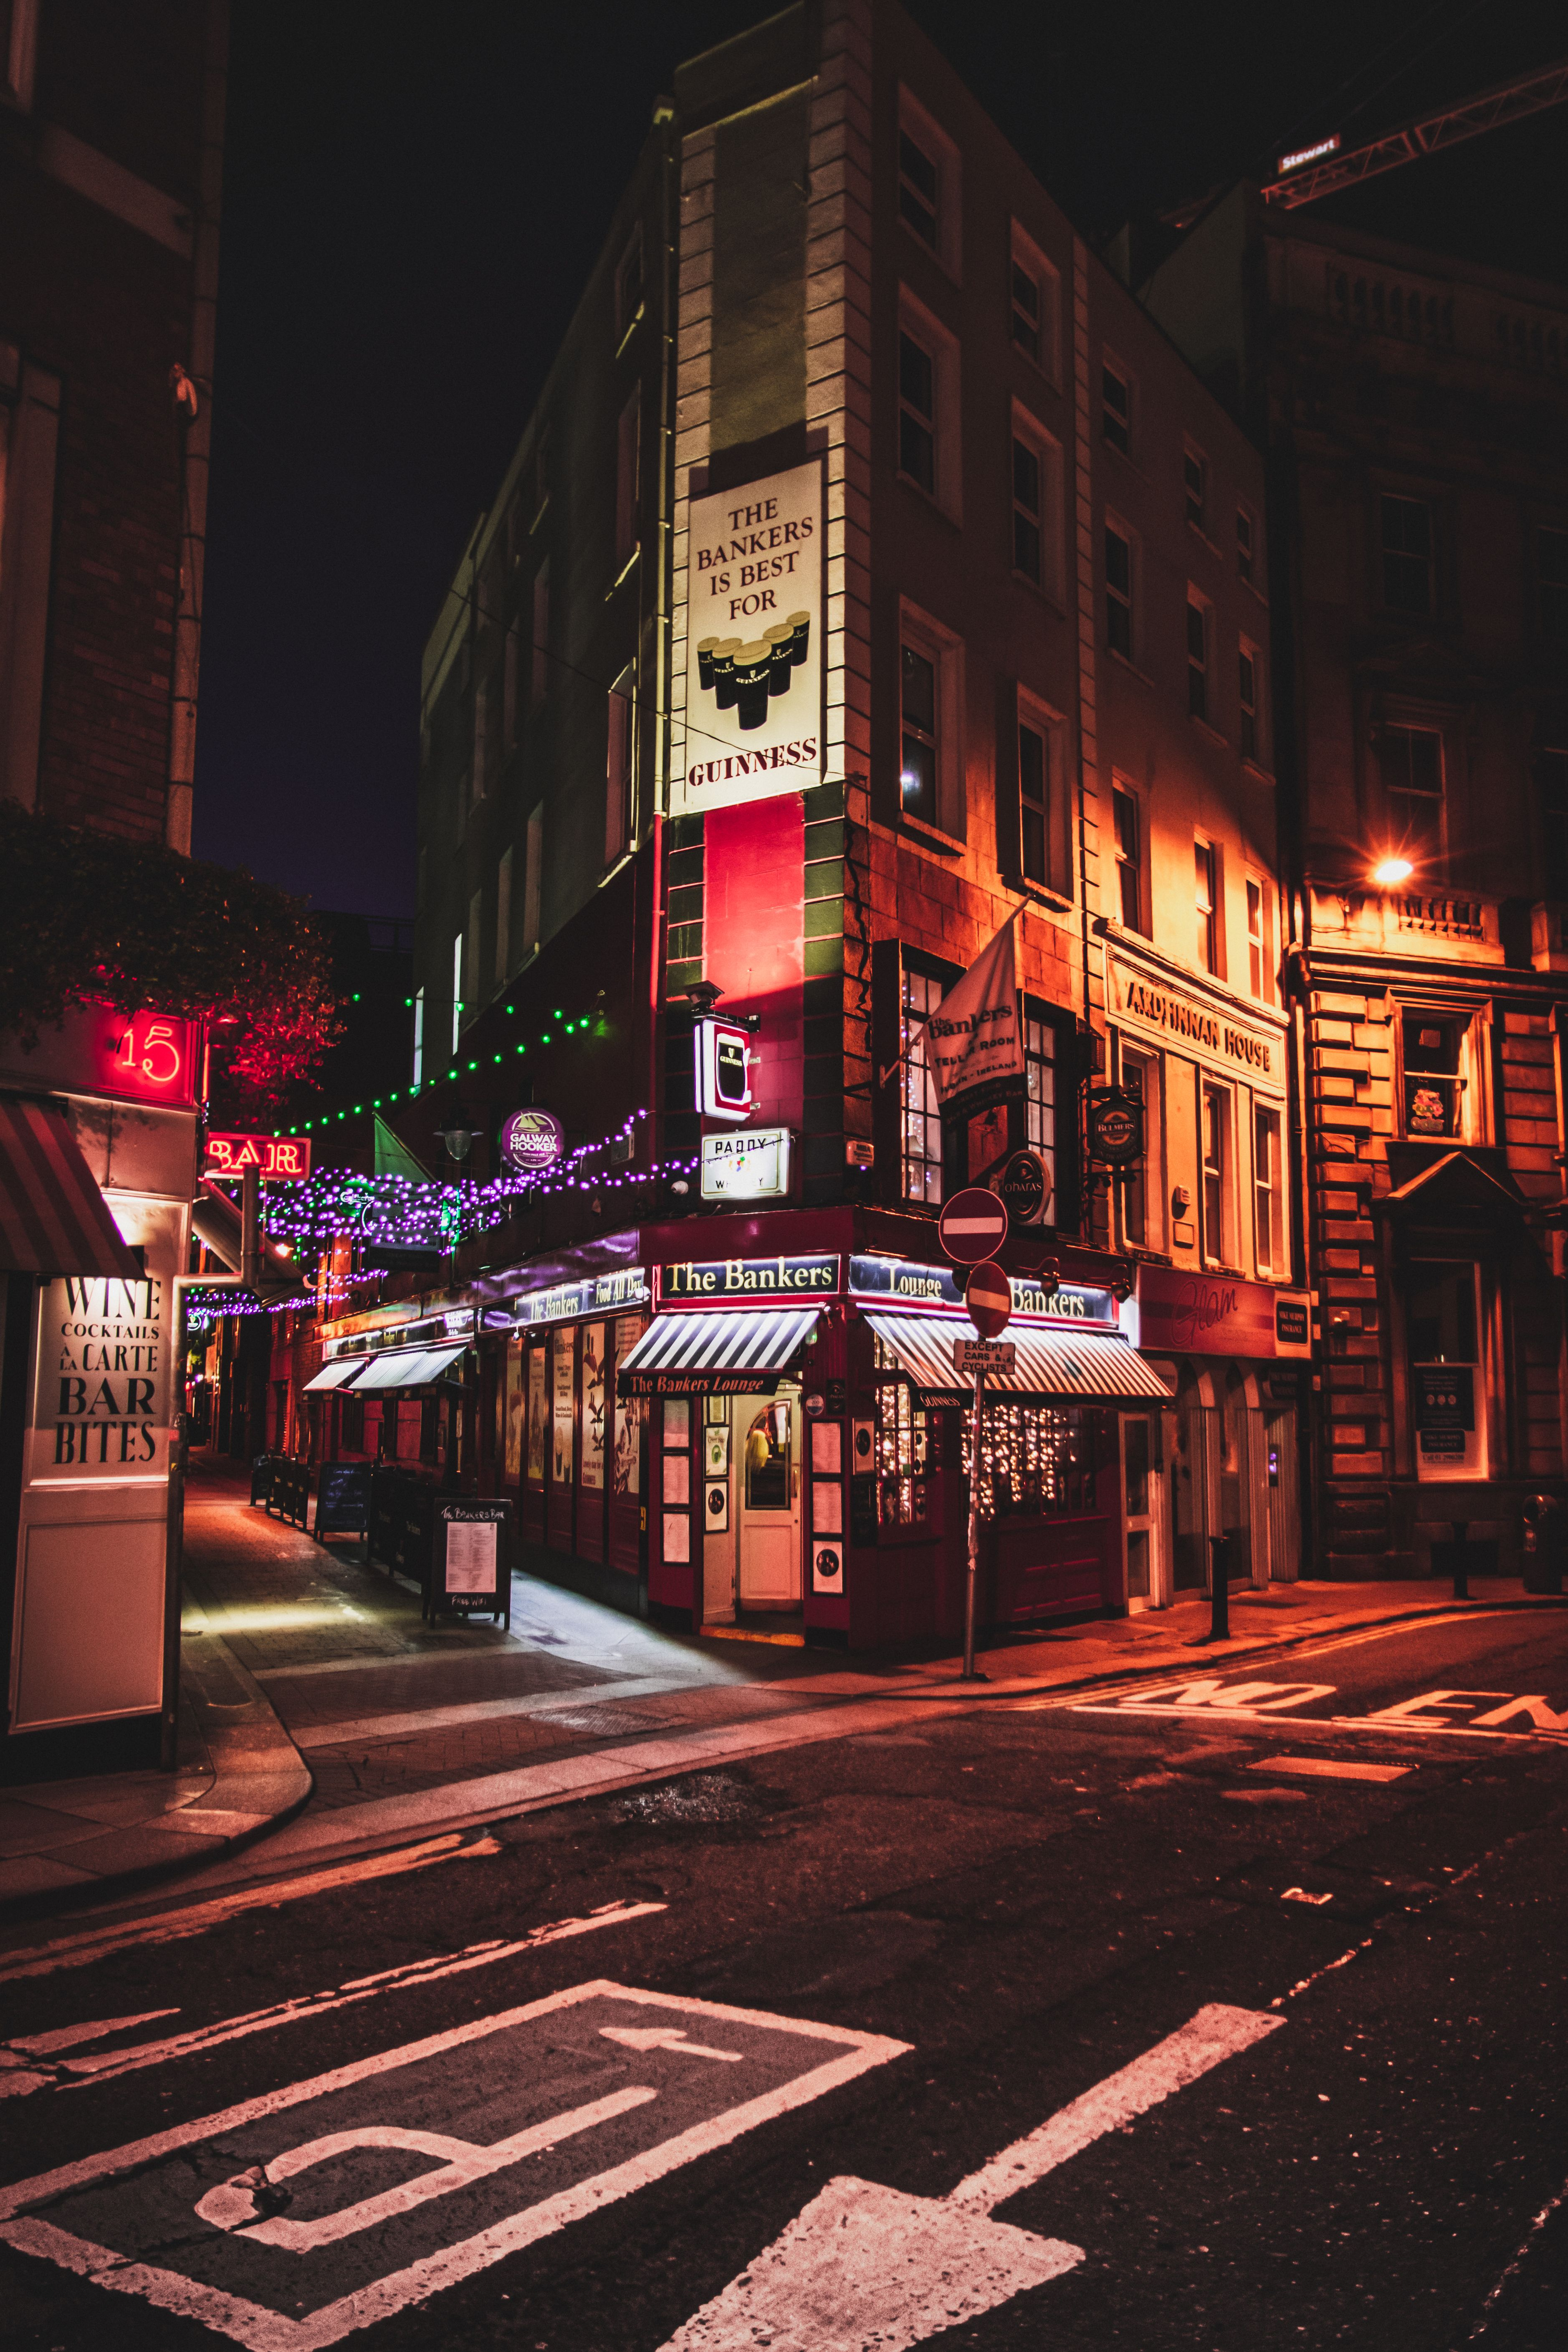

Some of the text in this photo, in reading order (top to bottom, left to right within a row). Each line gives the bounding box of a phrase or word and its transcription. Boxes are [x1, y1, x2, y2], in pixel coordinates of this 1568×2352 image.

[1283, 139, 1334, 169] Stewart
[728, 498, 778, 531] THE
[697, 517, 813, 571] BANKERS
[709, 551, 800, 596] IS BEST
[729, 590, 778, 620] FOR
[688, 737, 817, 787] GUINNESS
[1127, 983, 1270, 1071] ARDFINNAN HOUSE
[122, 1025, 180, 1081] 15
[980, 1037, 1014, 1051] ROOM
[720, 1056, 742, 1067] GUINNESS
[977, 1060, 1017, 1076] IRELAND
[510, 1133, 557, 1143] GALWAY
[510, 1142, 558, 1151] HOOKER
[715, 1138, 766, 1154] PADDY
[209, 1140, 302, 1173] BAR
[666, 1257, 832, 1291] The Bankers
[65, 1277, 161, 1320] WINE
[531, 1276, 641, 1321] The Bankers Food All Day
[890, 1266, 1085, 1317] Lounge Bankers
[1279, 1310, 1305, 1321] MIKE MURPHY
[1282, 1324, 1302, 1333] INSURANCE
[61, 1323, 159, 1339] COCKTAILS
[60, 1344, 158, 1372] LA CARTE
[964, 1352, 989, 1361] CARS
[965, 1342, 1004, 1352] EXCEPT
[962, 1362, 1006, 1371] CYCLISTS
[58, 1377, 157, 1415] BAR
[630, 1376, 764, 1393] The Bankers Lounge
[920, 1391, 960, 1406] GUINNESS
[53, 1421, 156, 1463] BITES
[454, 1507, 490, 1520] BANKERS
[490, 1508, 505, 1519] BAR
[1117, 1679, 1336, 1710] NO
